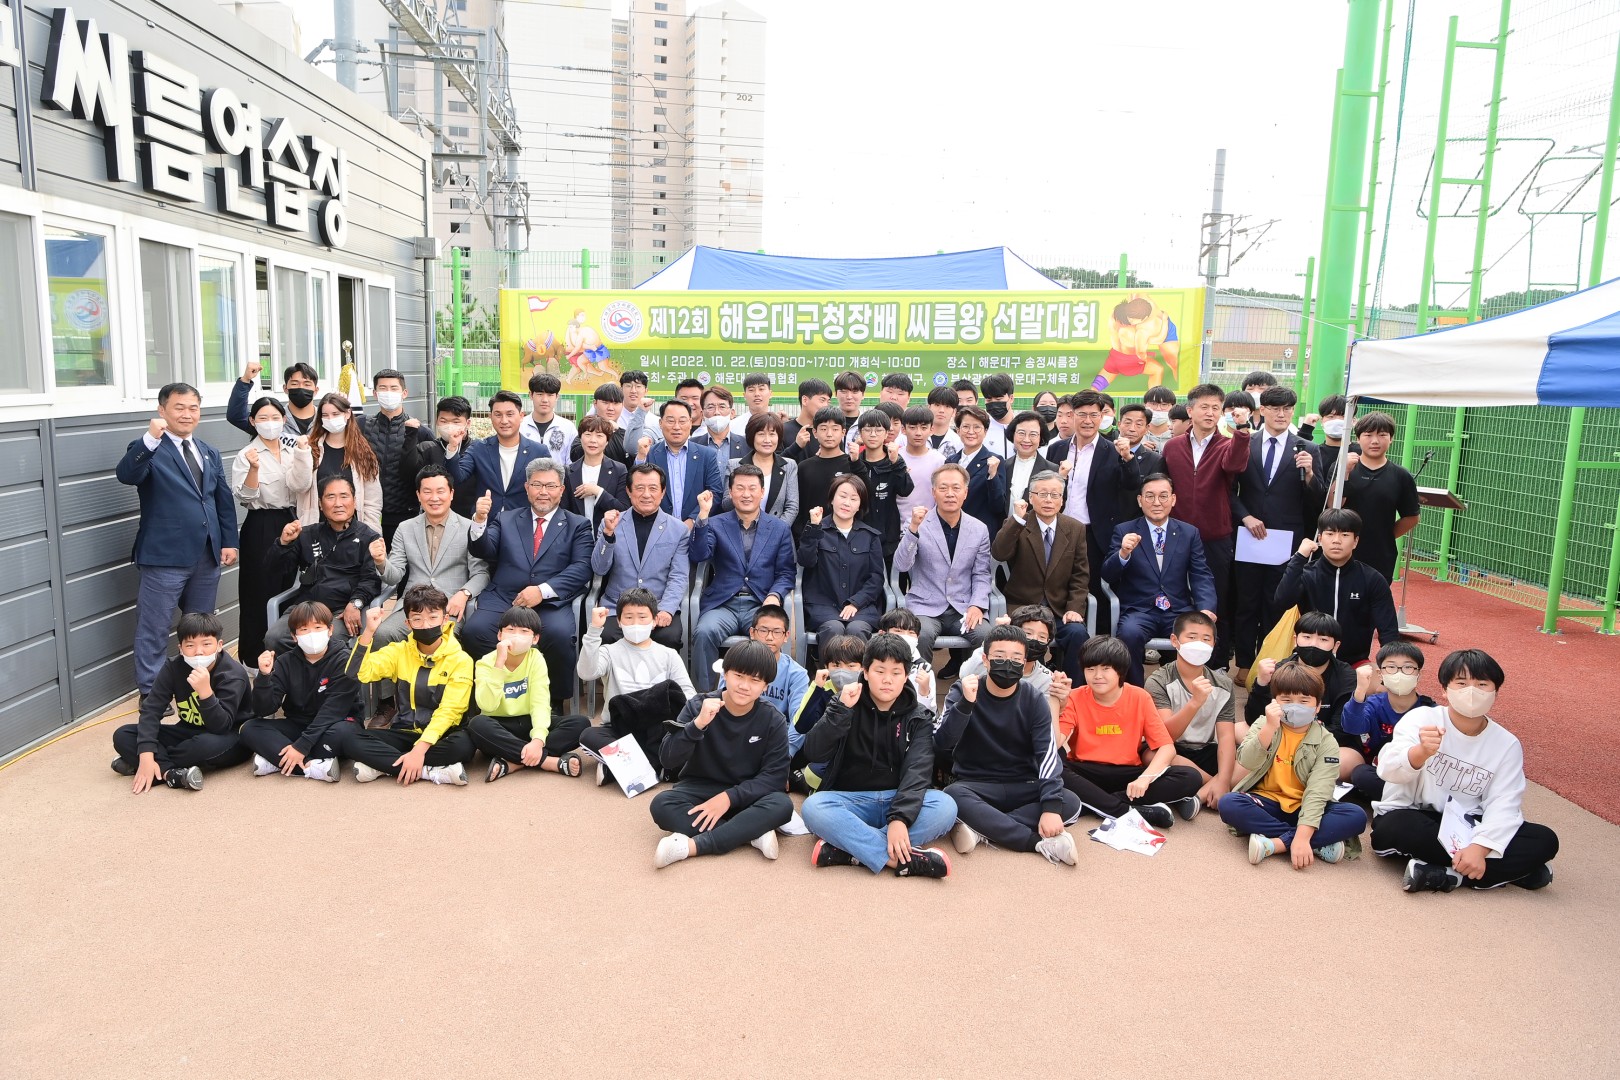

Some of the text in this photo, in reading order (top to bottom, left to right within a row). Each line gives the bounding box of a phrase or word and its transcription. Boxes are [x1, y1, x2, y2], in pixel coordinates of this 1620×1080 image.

[736, 93, 753, 102] 202
[650, 307, 709, 335] 제12회
[719, 303, 897, 341] 해운대구청장배
[906, 303, 984, 341] 씨름왕
[993, 302, 1096, 341] 선발대회
[640, 355, 661, 367] 일시
[671, 355, 707, 367] 2022.
[711, 356, 727, 367] 10.
[849, 356, 920, 369] 개회식-10:00
[947, 356, 968, 369] 장소
[979, 356, 1021, 369] 해운대구
[1025, 356, 1079, 369] 송정씨름장
[715, 372, 797, 385] 해운대름협회
